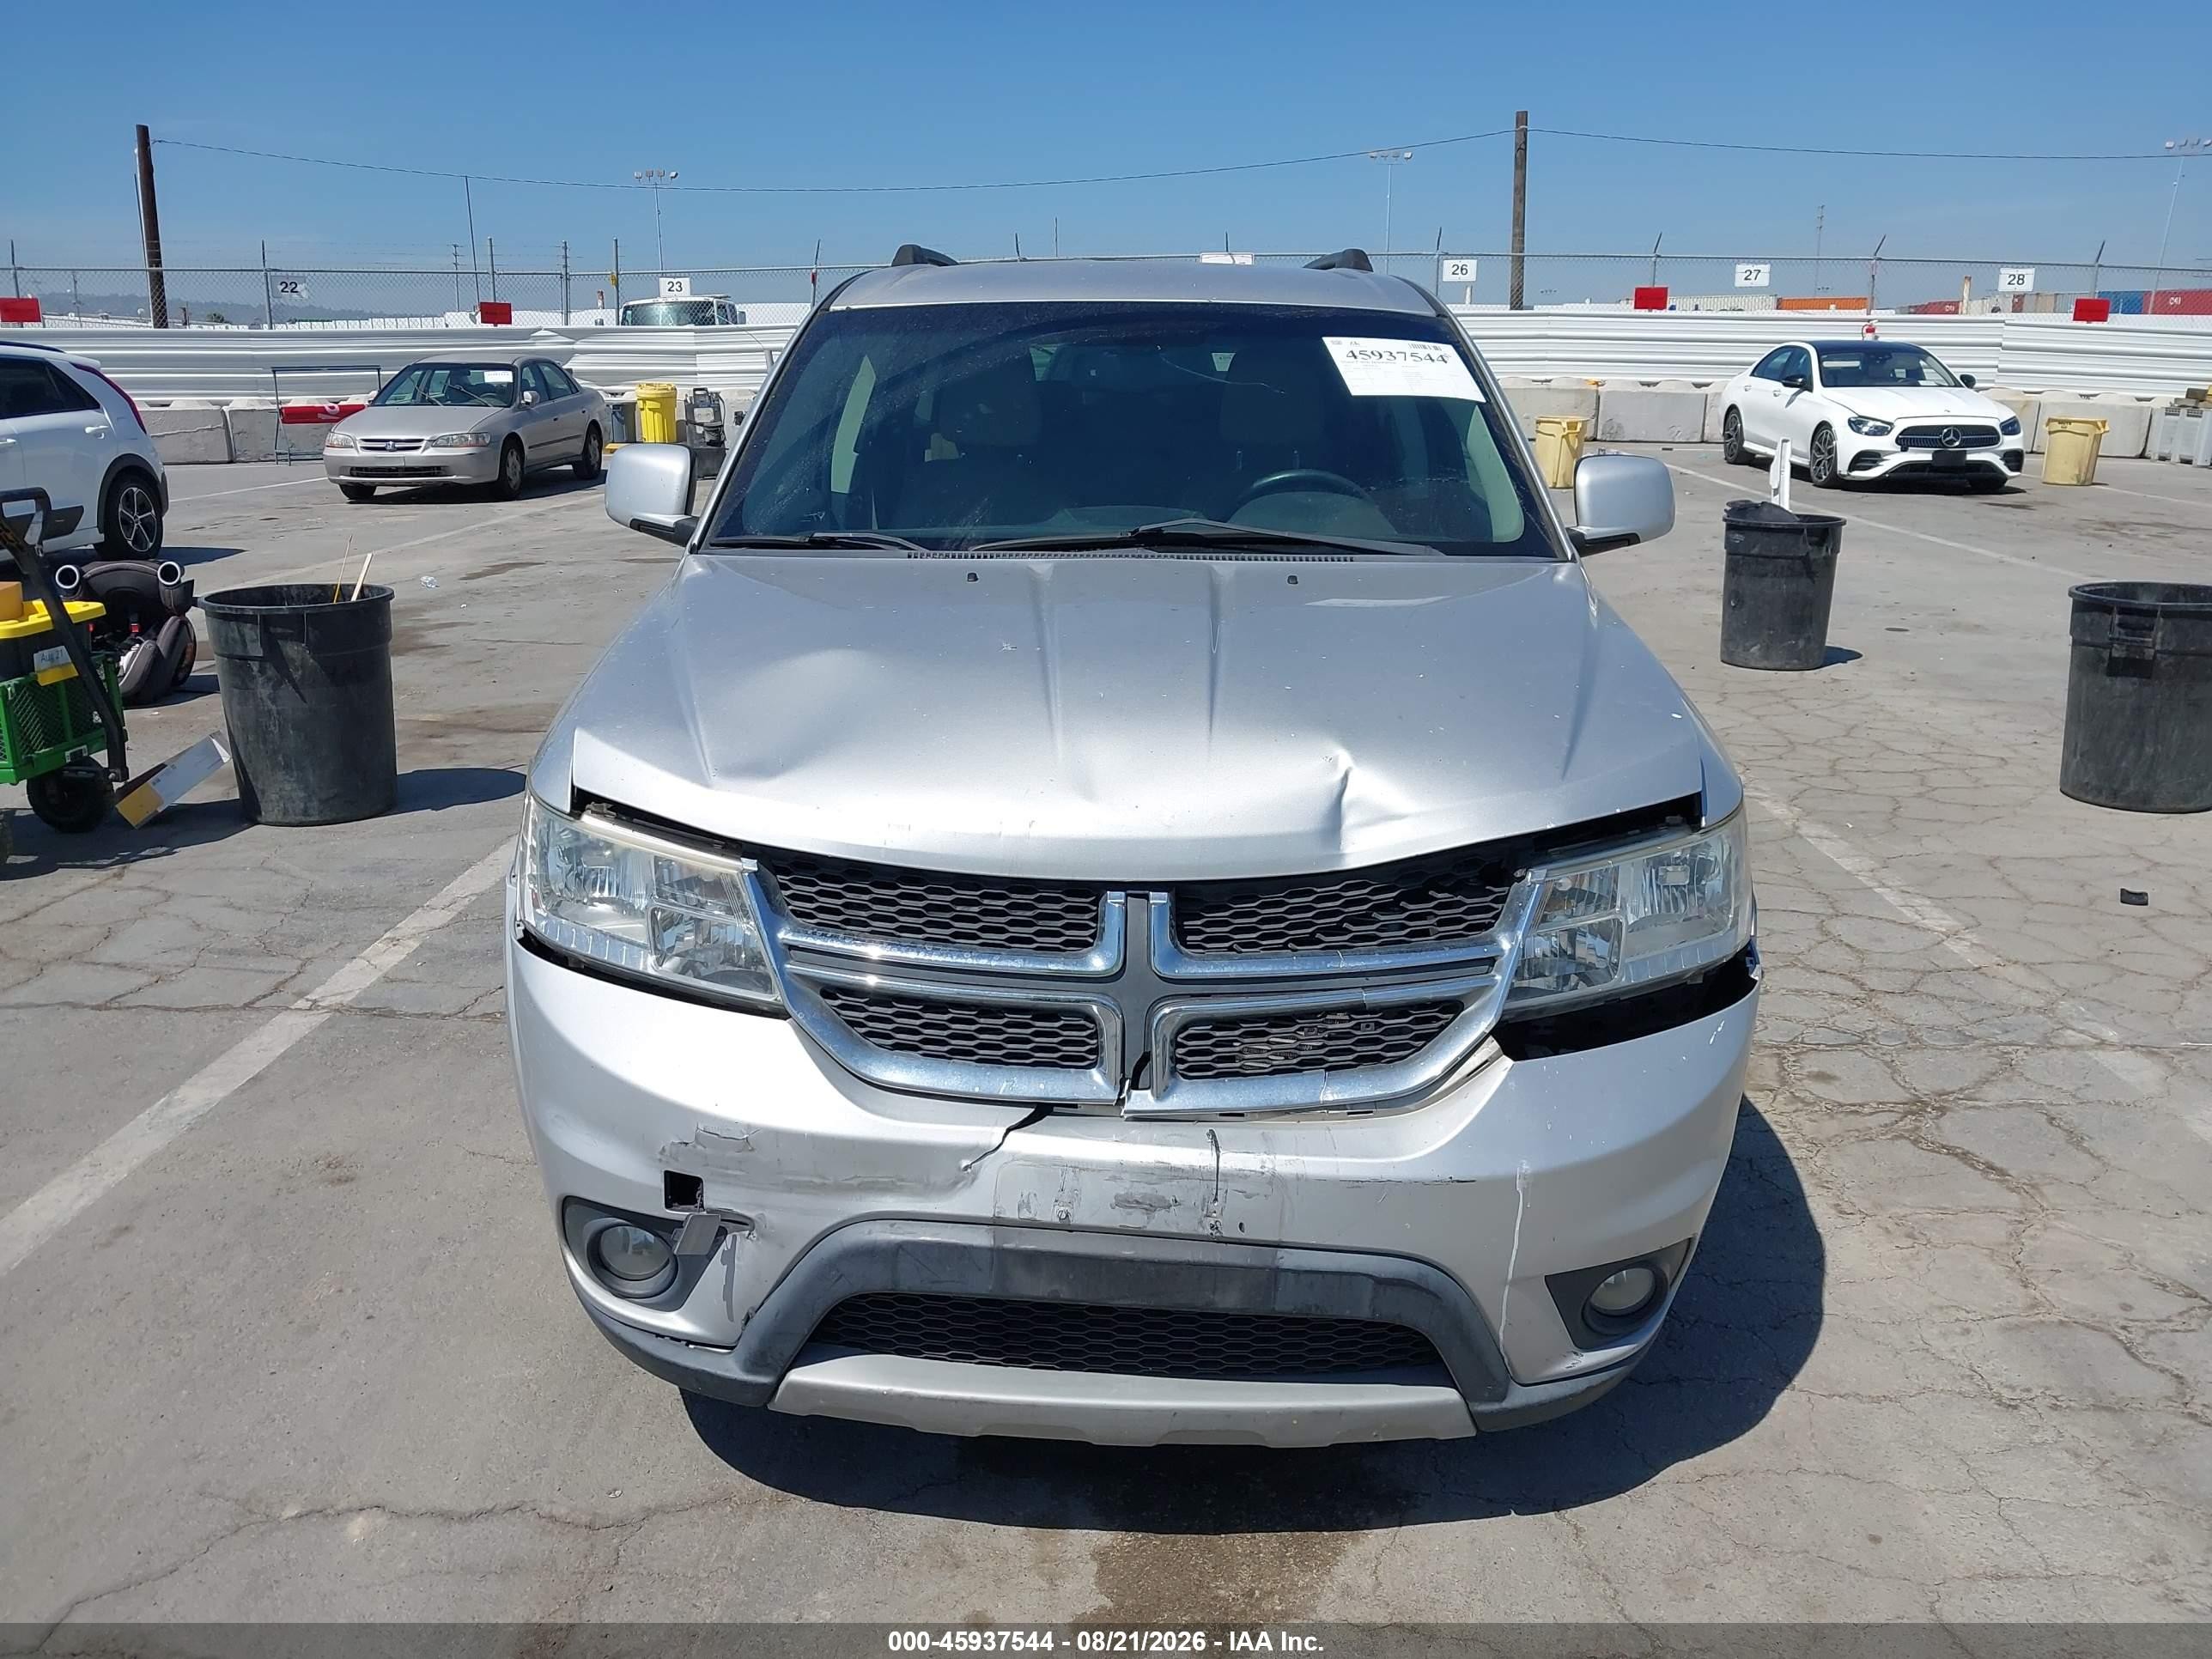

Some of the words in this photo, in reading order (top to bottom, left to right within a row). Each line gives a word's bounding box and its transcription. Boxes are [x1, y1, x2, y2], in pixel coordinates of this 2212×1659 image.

[1451, 264, 1468, 276] 26
[1744, 269, 1761, 281] 27
[2007, 274, 2026, 286] 28
[279, 281, 299, 294] 22
[667, 281, 684, 293] 23
[1346, 349, 1449, 364] 45937544
